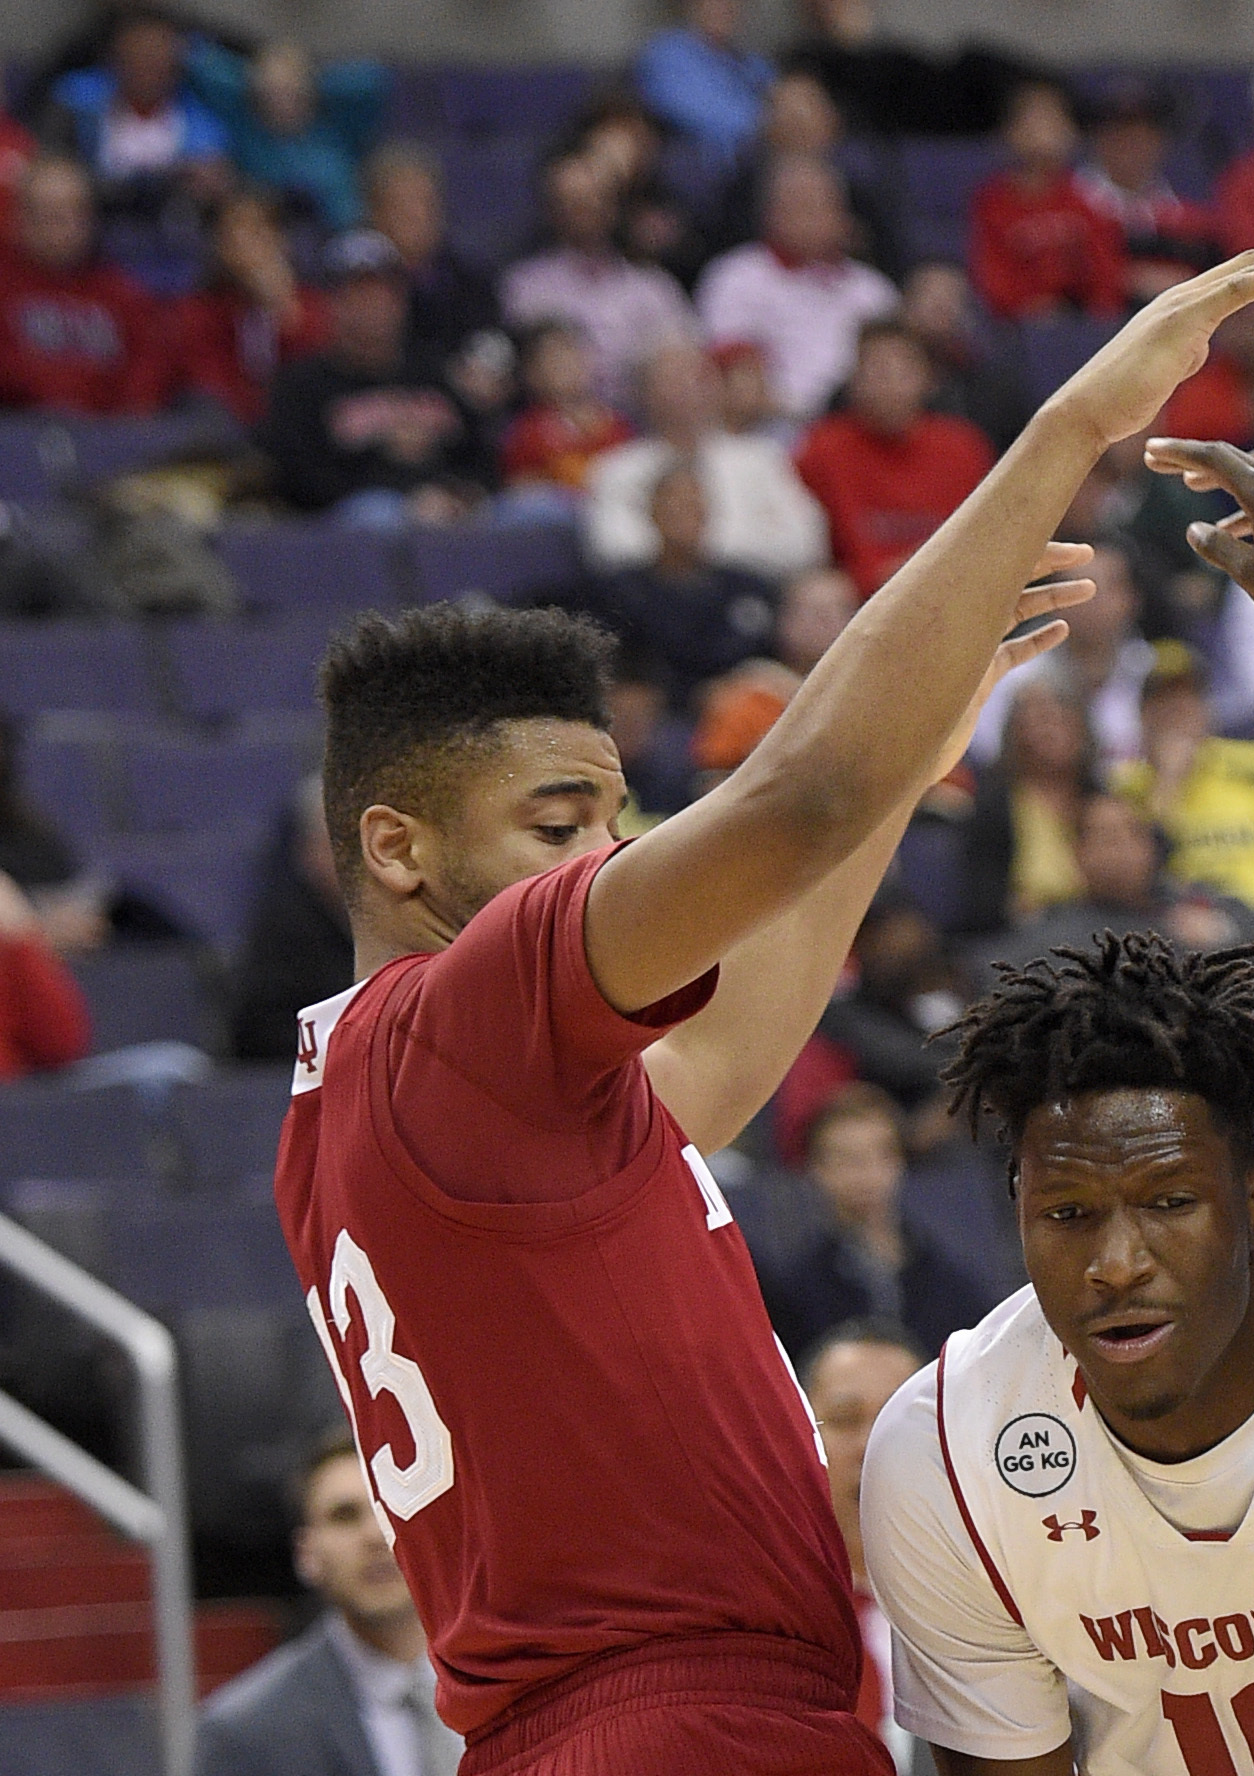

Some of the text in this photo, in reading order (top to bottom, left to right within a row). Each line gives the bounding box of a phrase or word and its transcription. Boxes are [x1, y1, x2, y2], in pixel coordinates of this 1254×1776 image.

[1018, 1430, 1050, 1450] AN
[1003, 1450, 1070, 1473] GG KG
